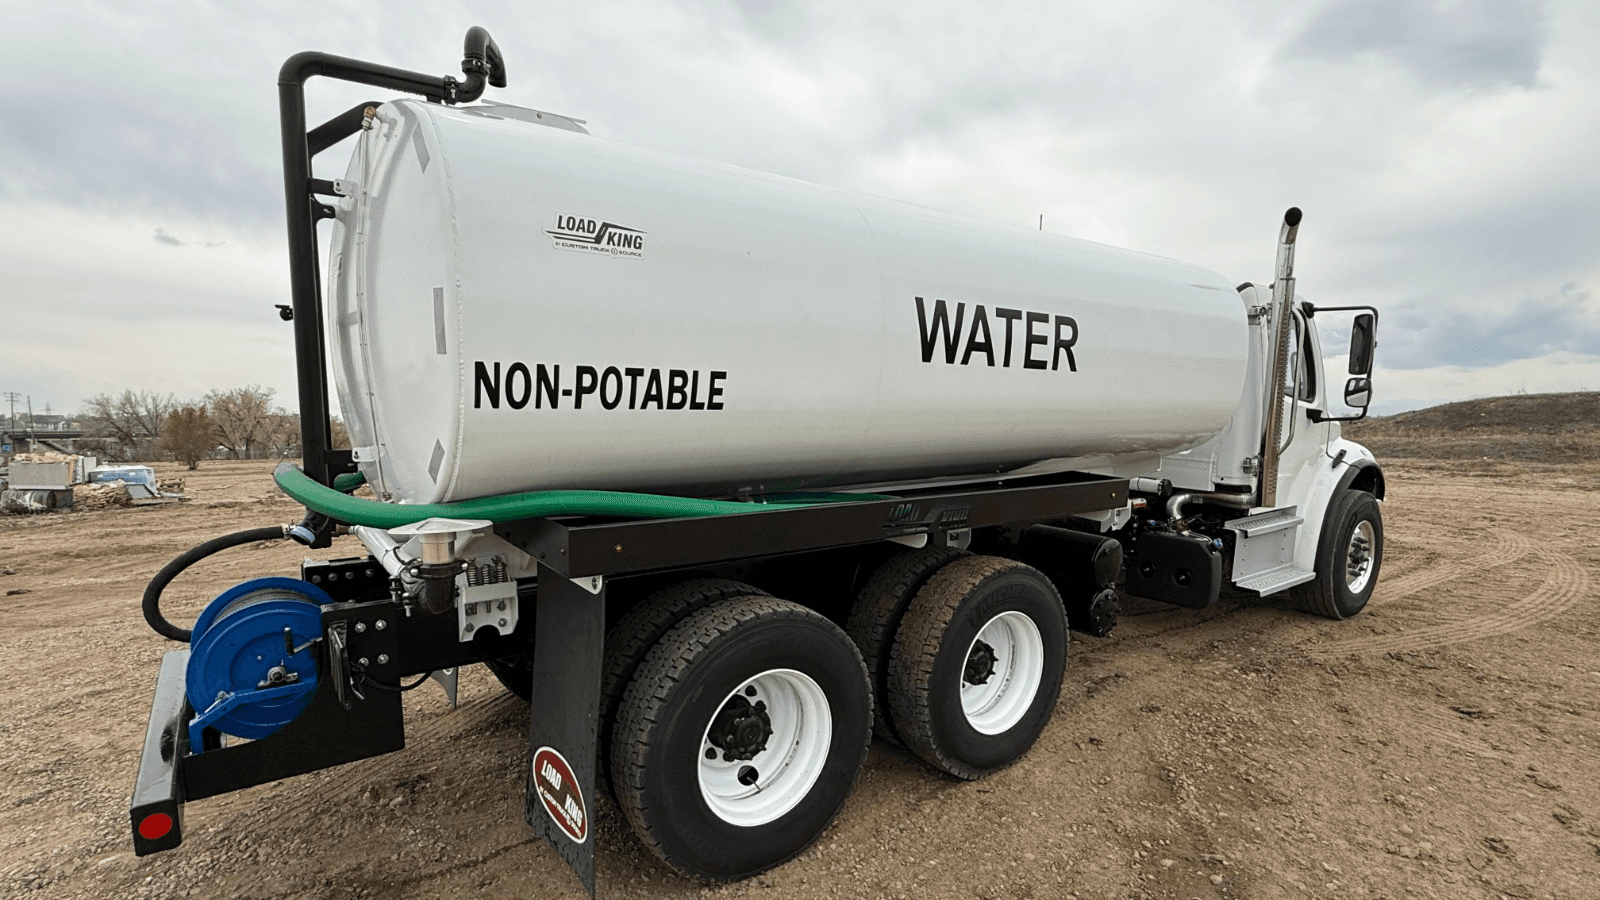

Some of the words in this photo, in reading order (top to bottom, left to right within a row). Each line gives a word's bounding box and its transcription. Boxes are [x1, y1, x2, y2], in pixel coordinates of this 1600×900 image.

[557, 215, 596, 234] LOAD
[607, 231, 643, 250] KING
[562, 242, 589, 250] CUSTOM
[590, 245, 611, 253] TRUCK
[618, 249, 642, 257] SOURCE
[914, 296, 1079, 372] WATER
[473, 360, 728, 411] NON-POTABLE
[540, 759, 562, 790] LOAD
[564, 793, 583, 828] KING
